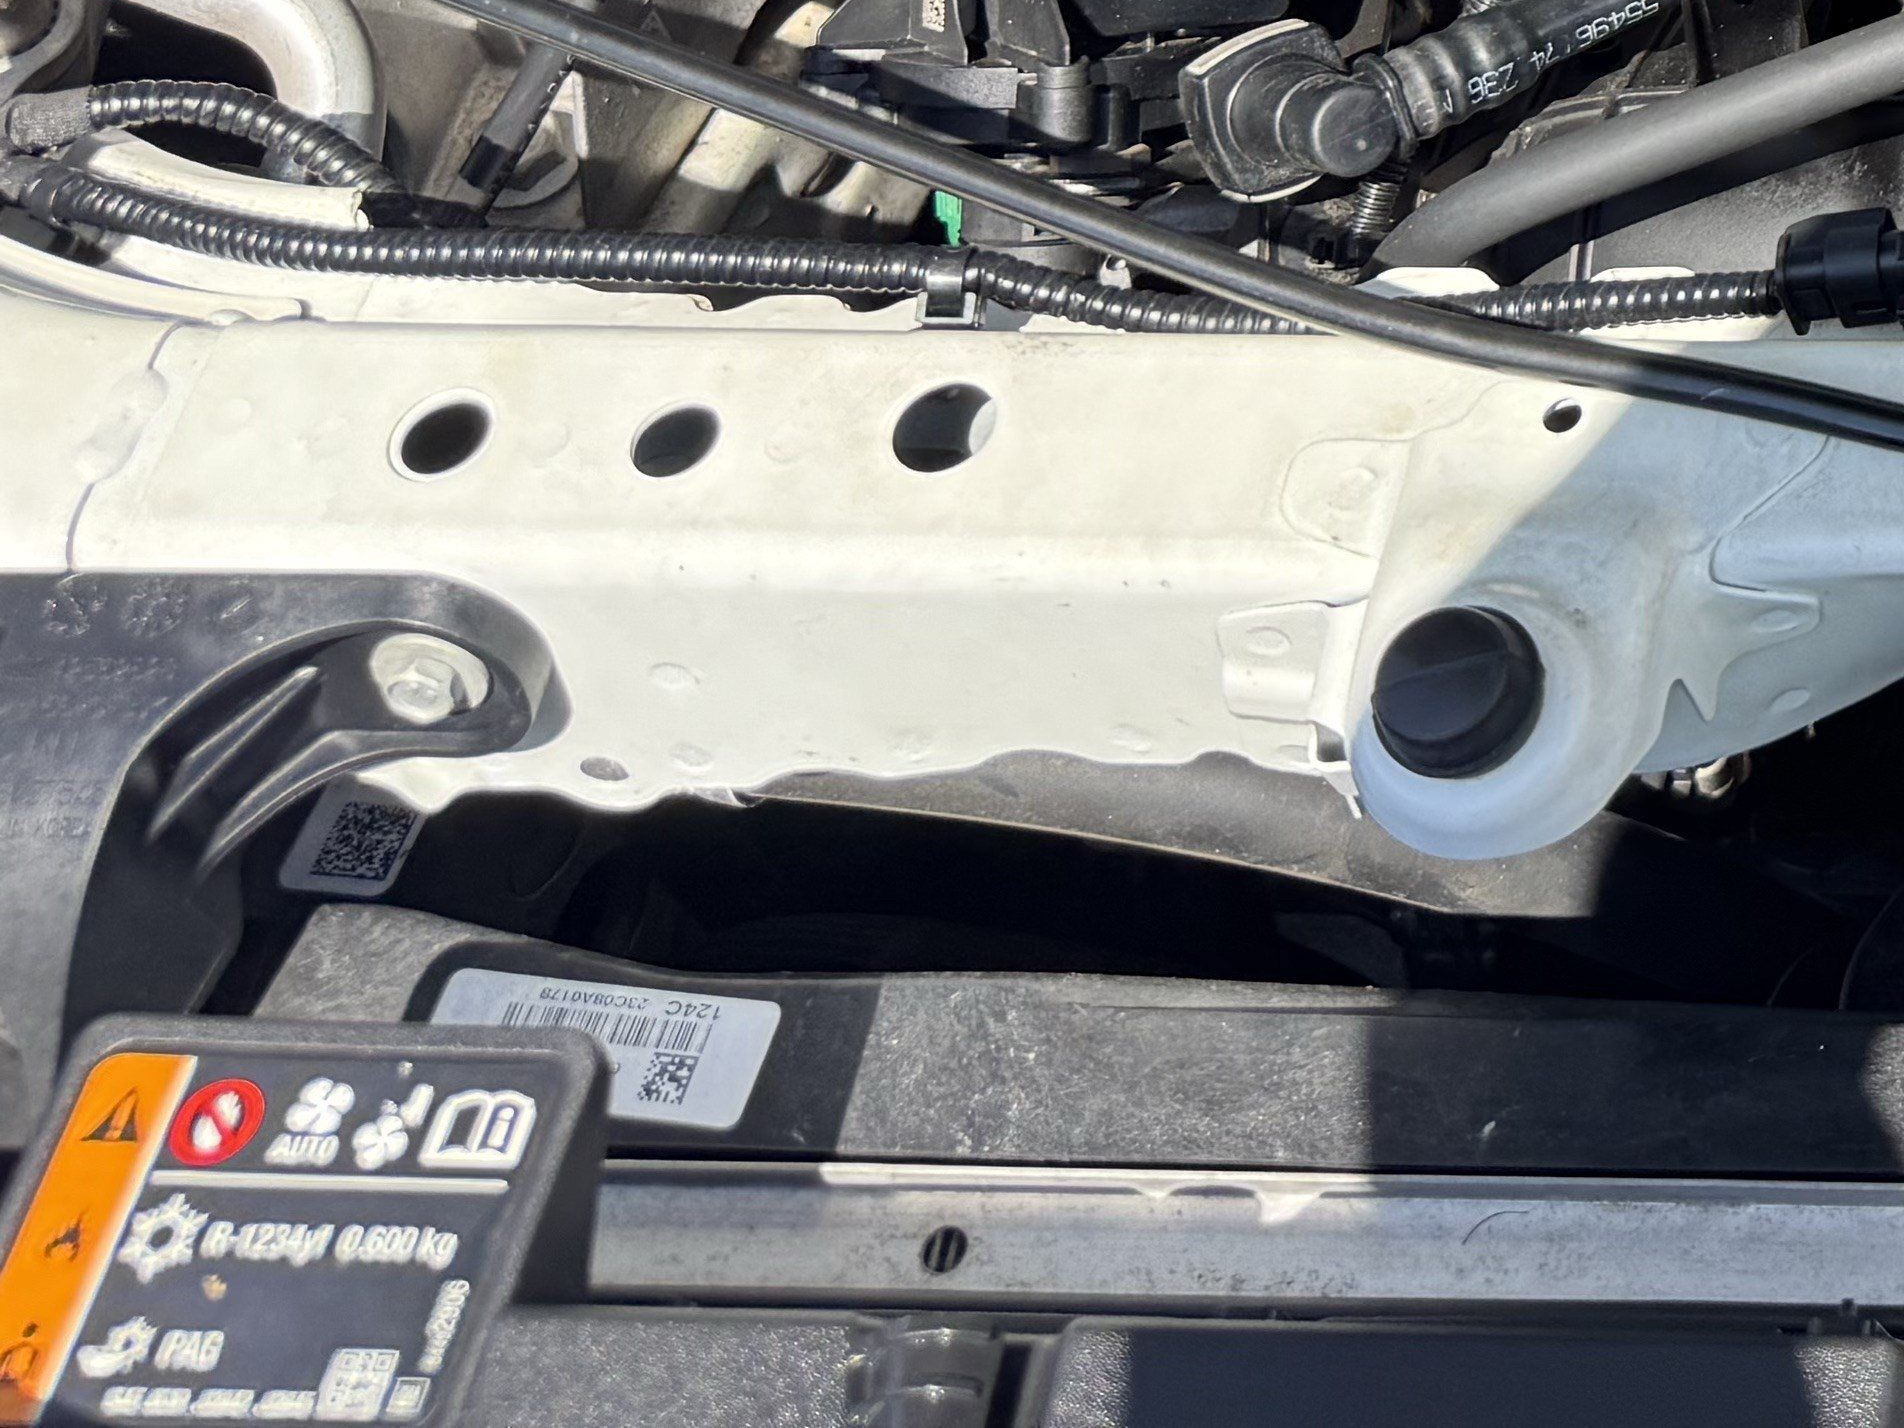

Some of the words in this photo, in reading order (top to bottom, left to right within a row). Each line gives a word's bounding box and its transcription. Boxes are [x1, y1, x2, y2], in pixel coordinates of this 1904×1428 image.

[664, 1000, 721, 1021] 124C
[263, 1133, 340, 1166] AUTO
[334, 1223, 420, 1267] 0.600
[416, 1226, 459, 1271] kg
[154, 1329, 226, 1372] PAG
